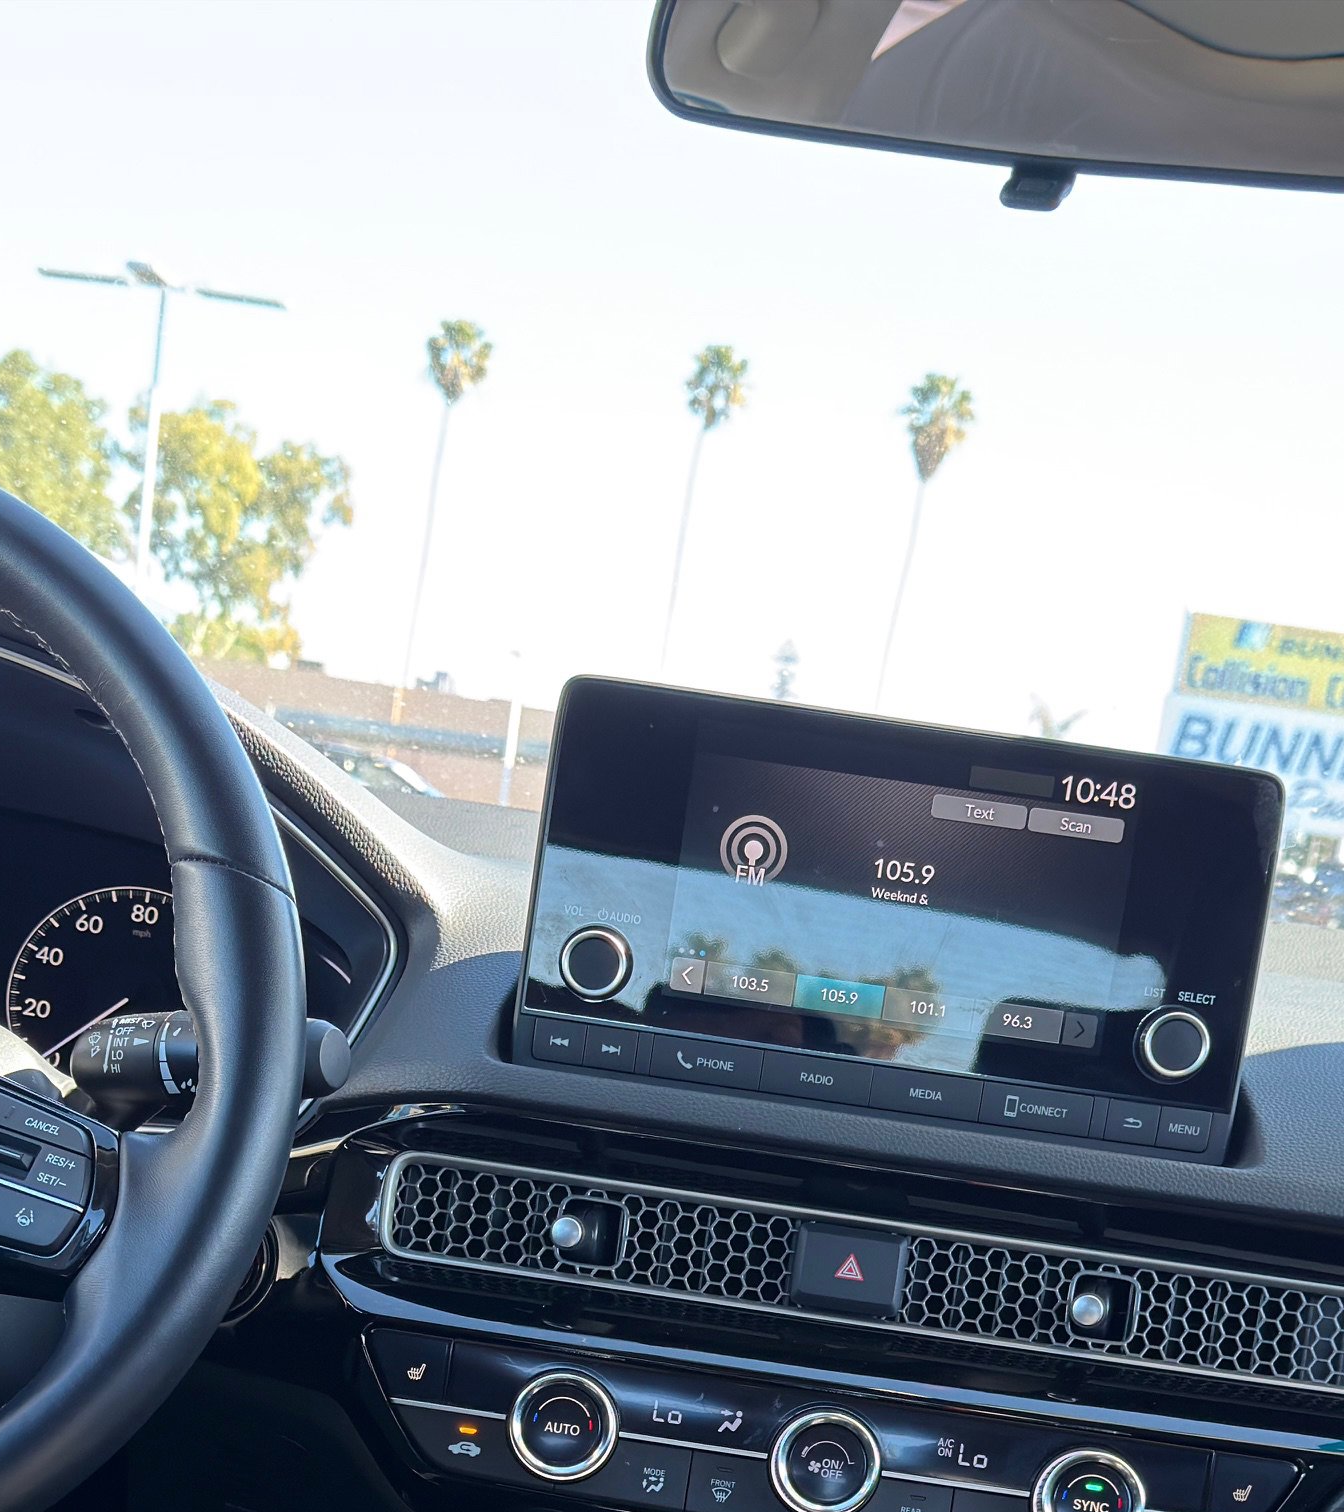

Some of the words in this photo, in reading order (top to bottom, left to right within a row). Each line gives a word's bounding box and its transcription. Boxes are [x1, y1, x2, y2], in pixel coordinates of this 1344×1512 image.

[1185, 654, 1311, 702] Collision
[1060, 774, 1137, 810] 10:48
[965, 803, 995, 821] Text
[1059, 817, 1092, 835] Scan
[735, 864, 766, 887] FM
[873, 858, 936, 885] 105.9
[871, 886, 918, 905] Weeknd
[919, 894, 929, 905] &
[130, 903, 159, 925] 80
[564, 904, 584, 917] VOL
[609, 911, 642, 925] AUDIO
[75, 913, 104, 934] 60
[35, 946, 64, 966] 40
[731, 975, 770, 993] 103.5
[1144, 985, 1166, 1000] LIST
[820, 987, 859, 1005] 105.9
[1177, 990, 1217, 1006] SELECT
[22, 997, 51, 1018] 20
[909, 1000, 947, 1018] 101.1
[1002, 1013, 1033, 1030] 96.3
[115, 1026, 136, 1036] OFF
[113, 1037, 130, 1047] INT
[111, 1050, 124, 1060] LO
[110, 1063, 121, 1074] HI
[696, 1056, 735, 1072] PHONE
[799, 1071, 834, 1087] RADIO
[908, 1086, 943, 1102] MEDIA
[1019, 1101, 1068, 1119] CONNECT
[24, 1117, 60, 1136] CANCEL
[1167, 1122, 1201, 1137] MENU
[543, 1420, 581, 1437] AUTO
[937, 1437, 955, 1448] A/C
[937, 1446, 953, 1458] ON
[642, 1466, 666, 1478] MODE
[820, 1467, 844, 1480] OFF
[821, 1458, 845, 1472] ON/
[710, 1478, 737, 1489] FRONT
